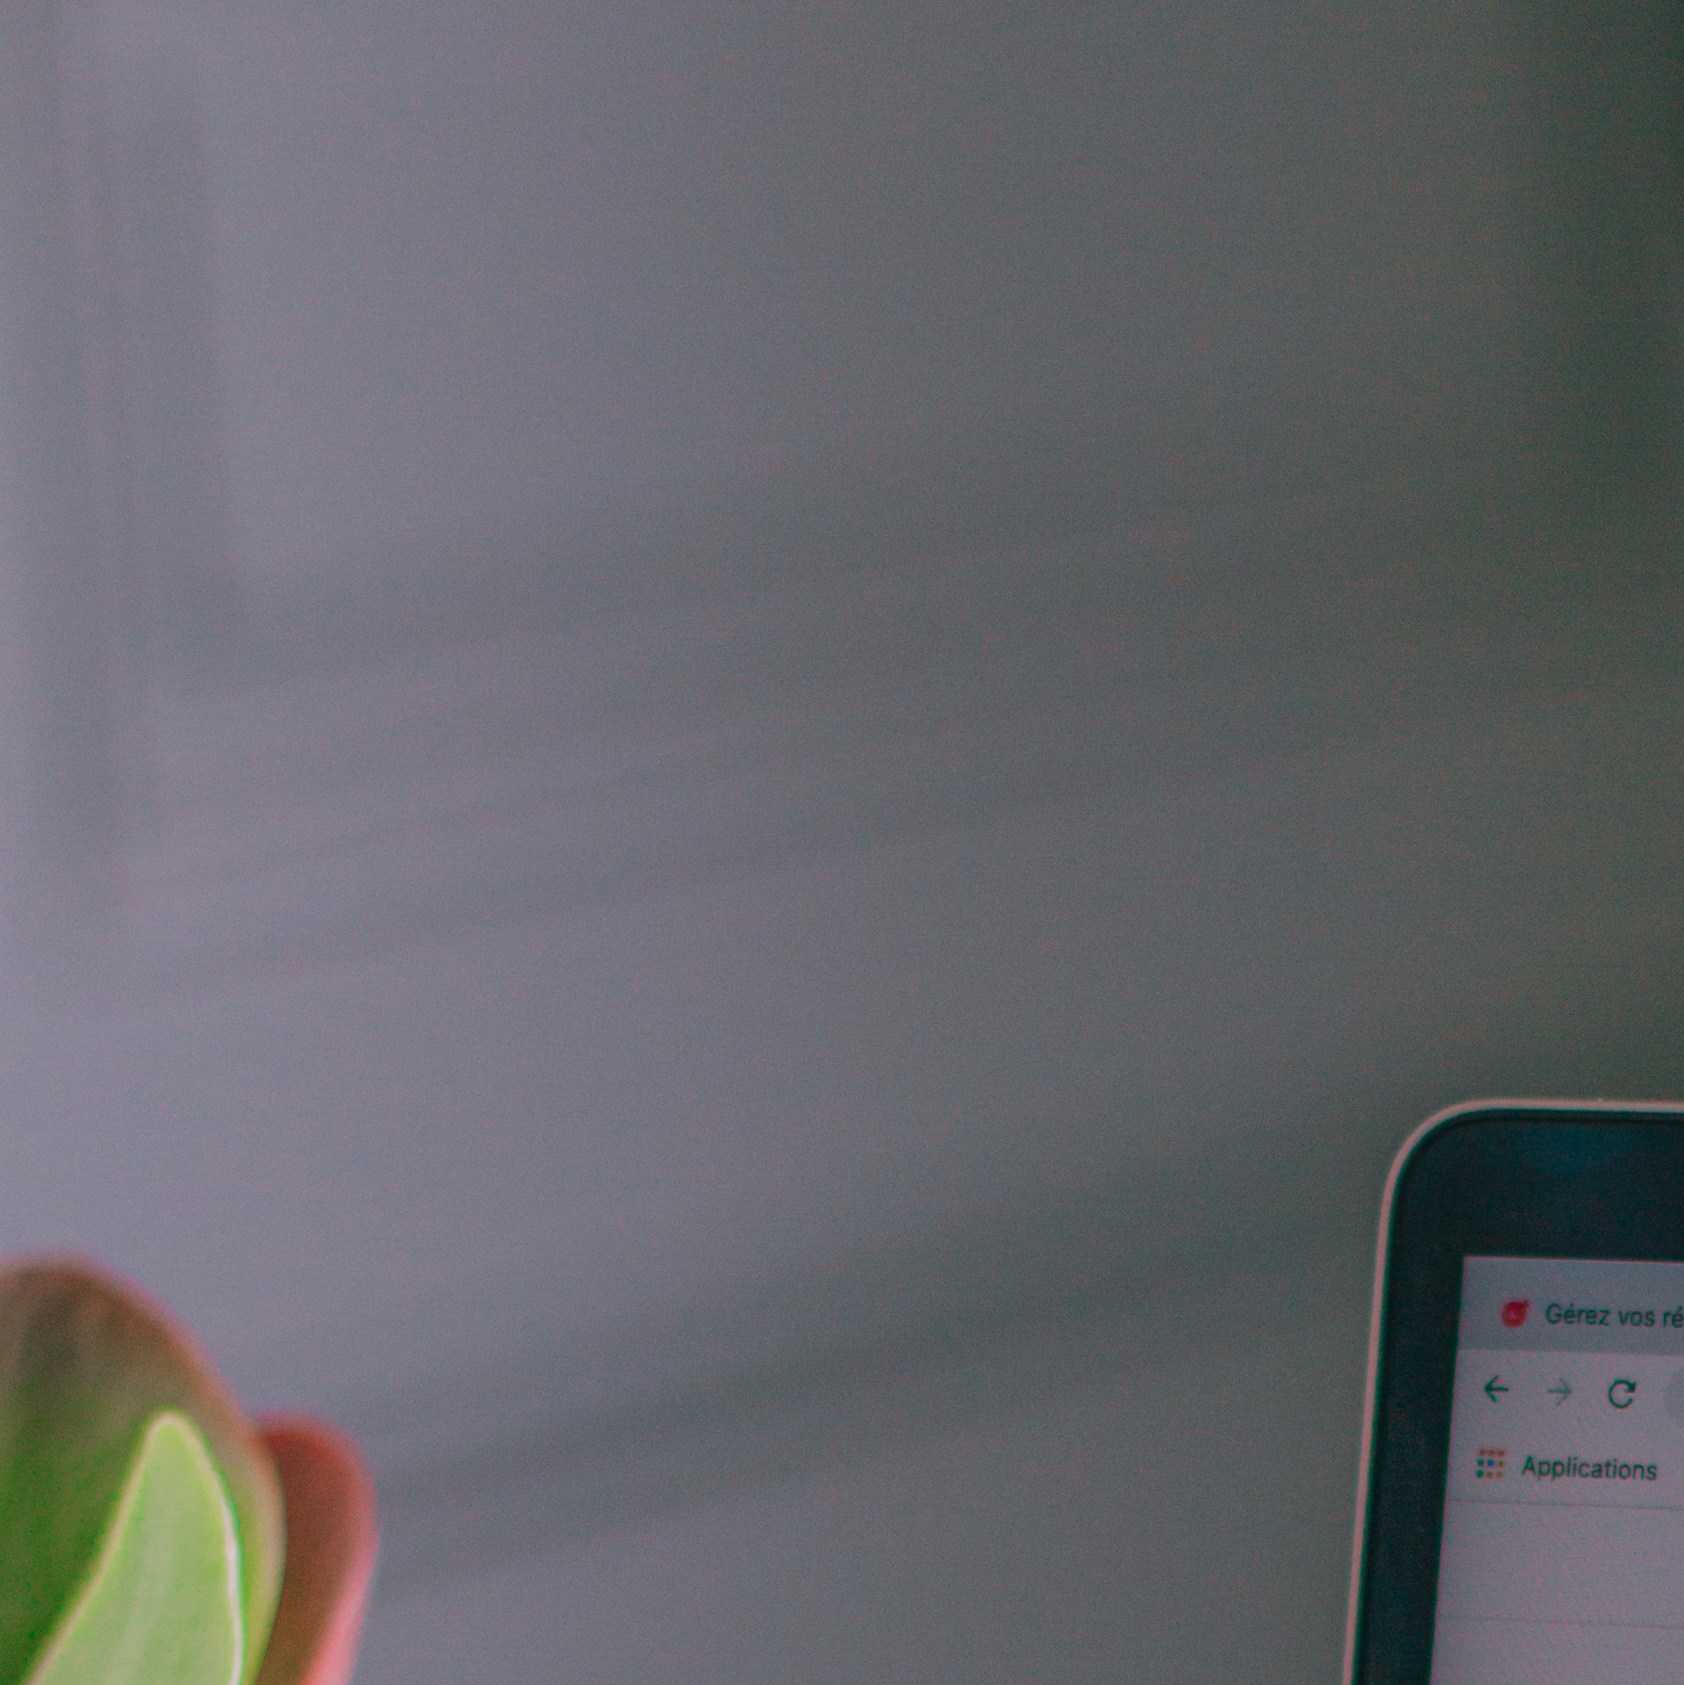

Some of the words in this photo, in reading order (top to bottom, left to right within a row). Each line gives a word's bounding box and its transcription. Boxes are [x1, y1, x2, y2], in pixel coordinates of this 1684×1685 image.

[1545, 1302, 1610, 1327] Gérez
[1618, 1309, 1655, 1328] vos
[1521, 1457, 1657, 1483] Applications
